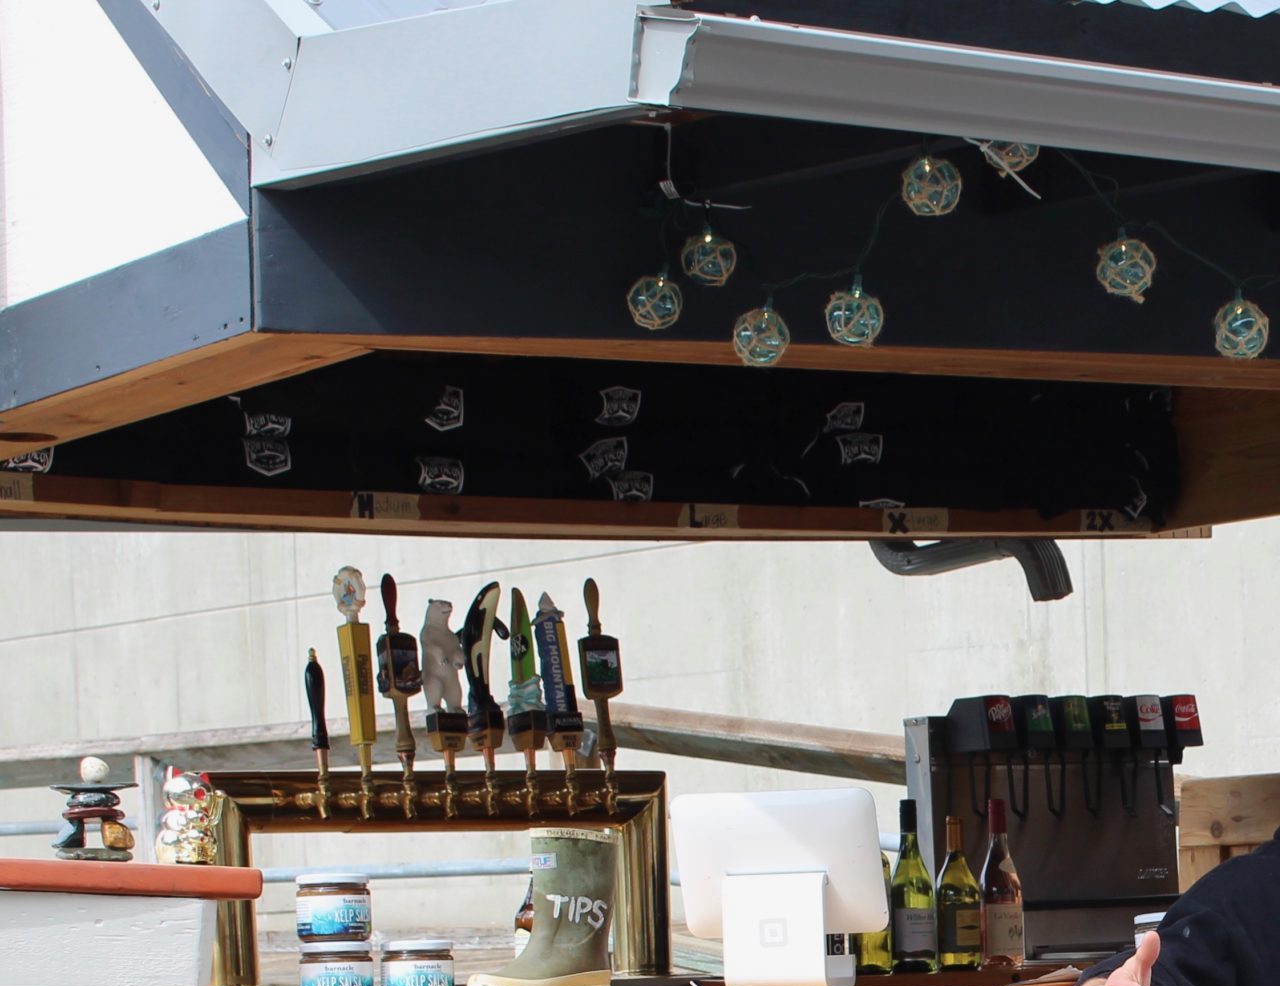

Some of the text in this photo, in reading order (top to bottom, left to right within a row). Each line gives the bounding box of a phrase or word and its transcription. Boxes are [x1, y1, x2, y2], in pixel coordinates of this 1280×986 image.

[544, 621, 567, 712] BIG MOUNTAIN
[335, 909, 354, 922] KELP
[546, 894, 607, 929] TIPS
